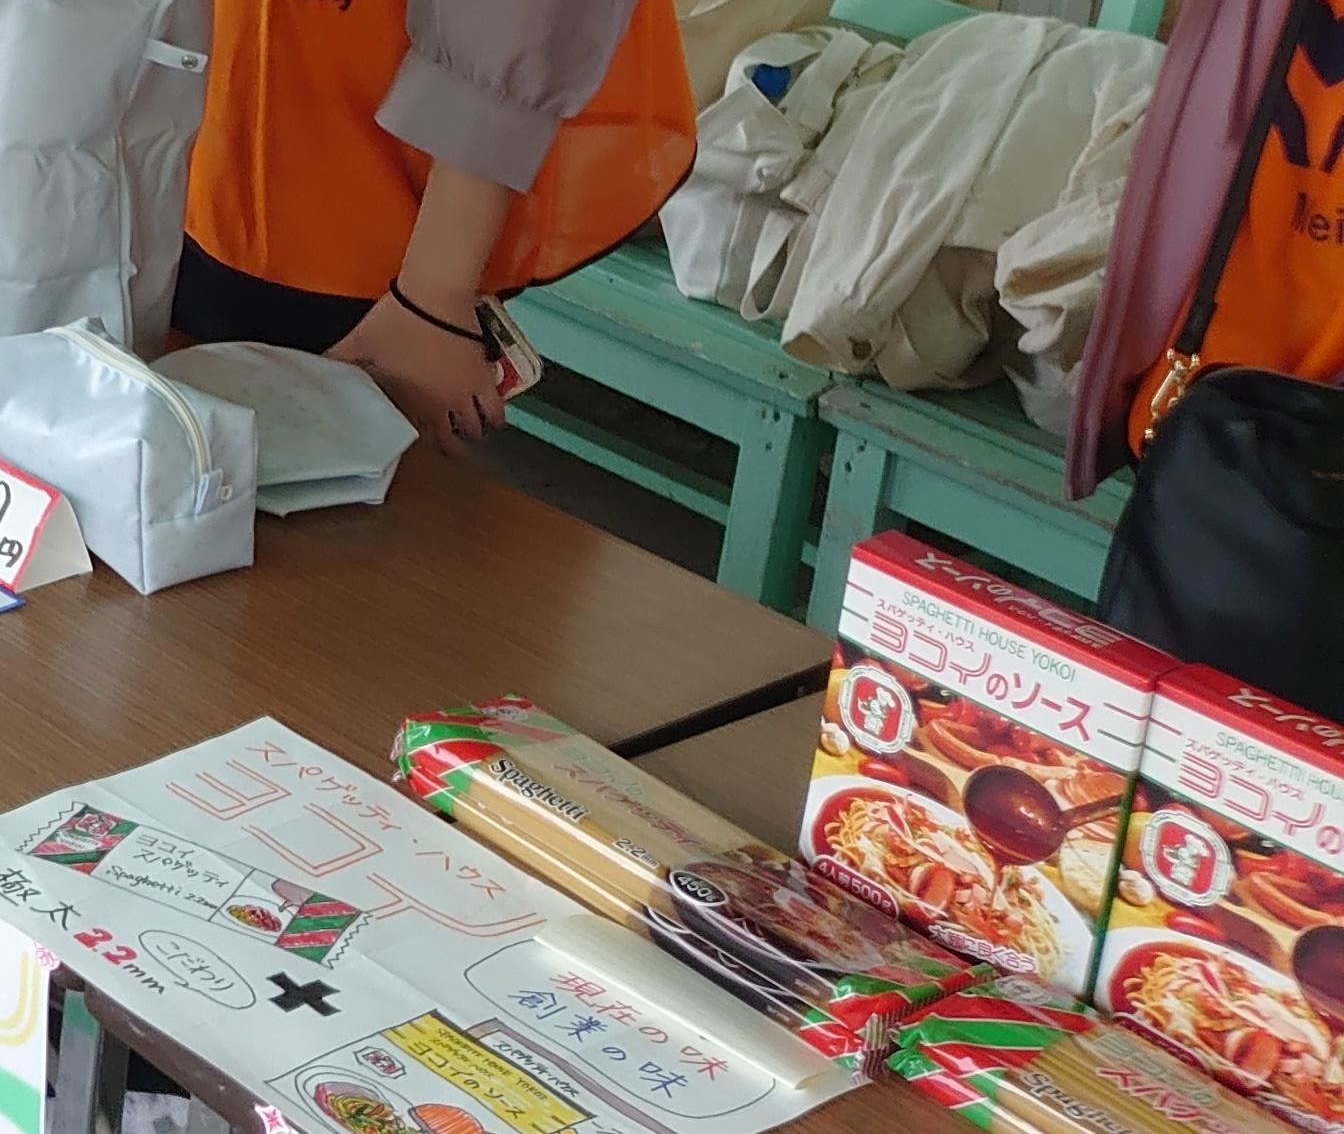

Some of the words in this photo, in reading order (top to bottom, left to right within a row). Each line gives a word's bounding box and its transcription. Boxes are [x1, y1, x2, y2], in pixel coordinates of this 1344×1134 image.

[870, 610, 1092, 742] ヨコイのソース
[901, 590, 976, 636] SPAGHETTI
[977, 627, 1026, 660] HOUSE
[1030, 647, 1077, 683] YOKOI
[488, 757, 592, 822] Spaghetti
[1215, 731, 1306, 782] SPAGHETTI
[244, 740, 507, 900] スパゲッティ・ハウス
[1177, 750, 1344, 856] ヨコイの
[106, 865, 182, 897] Spaghetti
[133, 848, 230, 889] スパゲッティ
[134, 833, 196, 859] ヨコイ
[166, 758, 548, 938] ヨコイ
[73, 927, 166, 995] 2.2mm
[155, 942, 235, 992] こだわり
[507, 989, 689, 1099] 創業の味
[549, 970, 730, 1082] 現在の味
[411, 1041, 527, 1120] ヨコイのソース
